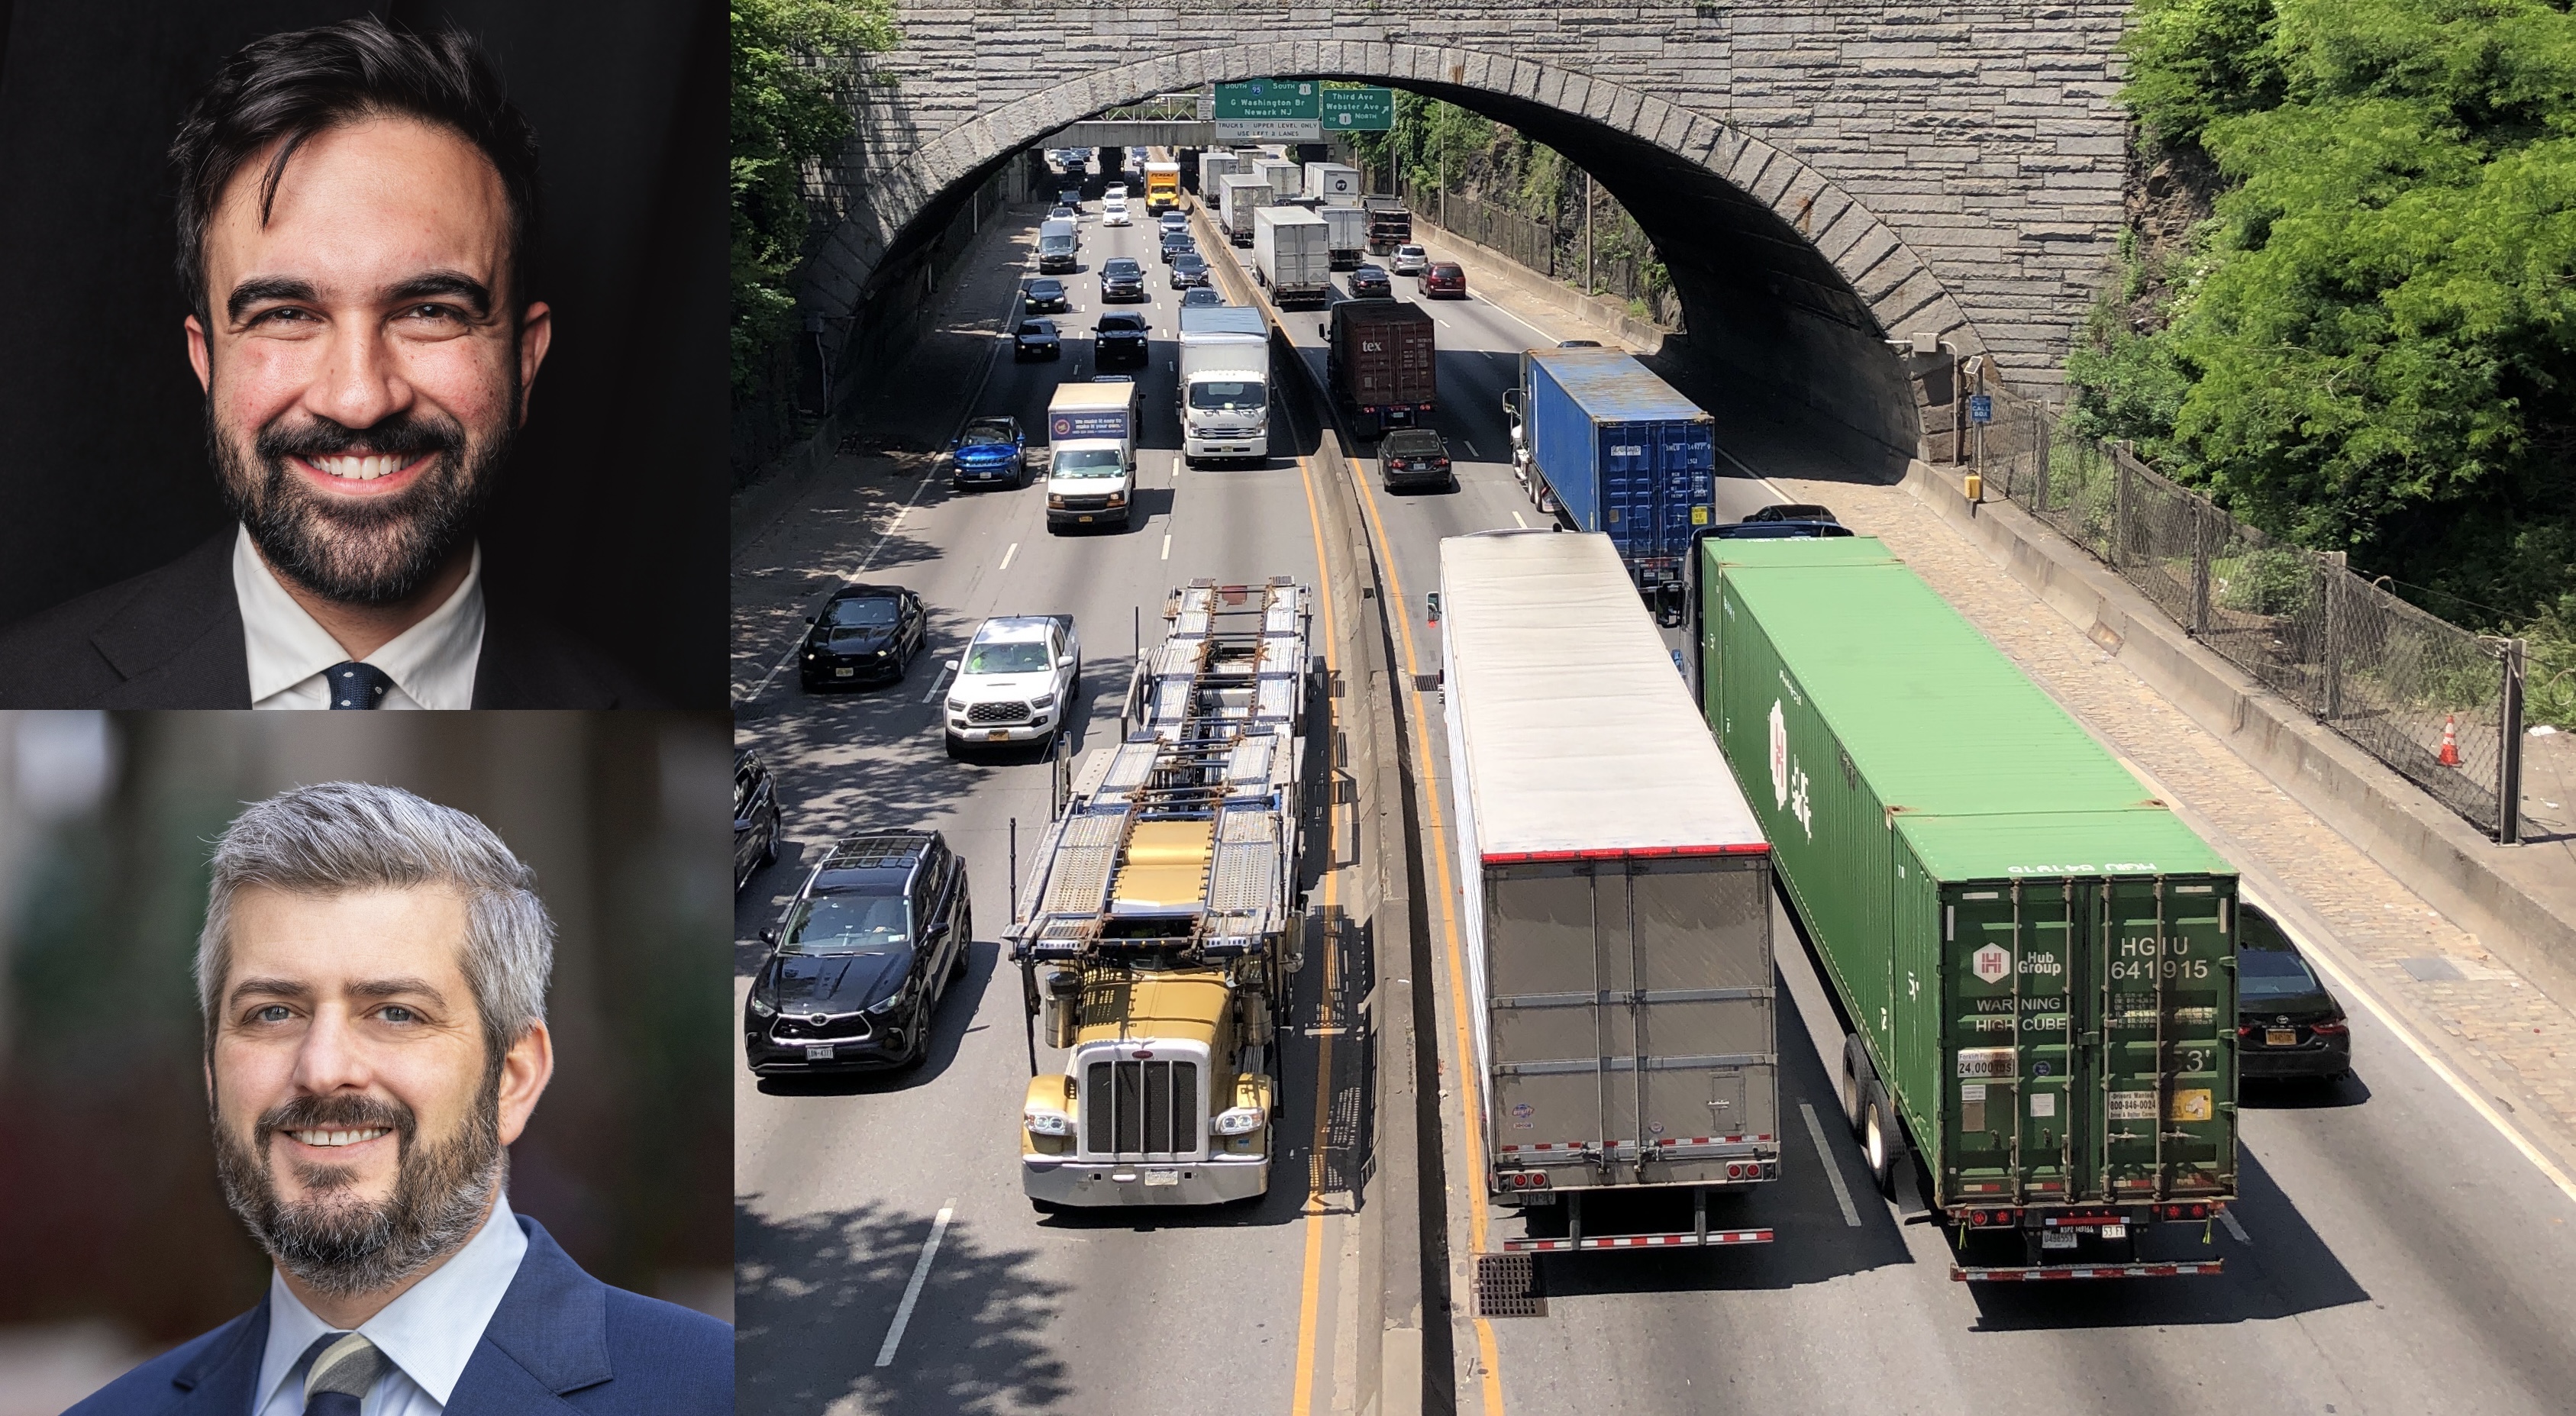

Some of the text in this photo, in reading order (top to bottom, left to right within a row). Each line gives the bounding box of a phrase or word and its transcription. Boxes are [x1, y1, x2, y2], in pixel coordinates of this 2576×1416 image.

[1241, 99, 1291, 108] Washington
[1362, 340, 1382, 352] tex
[2121, 937, 2188, 956] HGIU
[2028, 951, 2055, 963] Hub
[2018, 960, 2061, 976] Group
[2111, 960, 2208, 979] 641915
[1977, 998, 2061, 1011] WARNING
[1976, 1018, 2066, 1032] HIGH CUBE
[1959, 1062, 1993, 1075] 24,000
[2110, 1099, 2156, 1110] 800-846-0024
[2103, 1226, 2123, 1237] 53 FT
